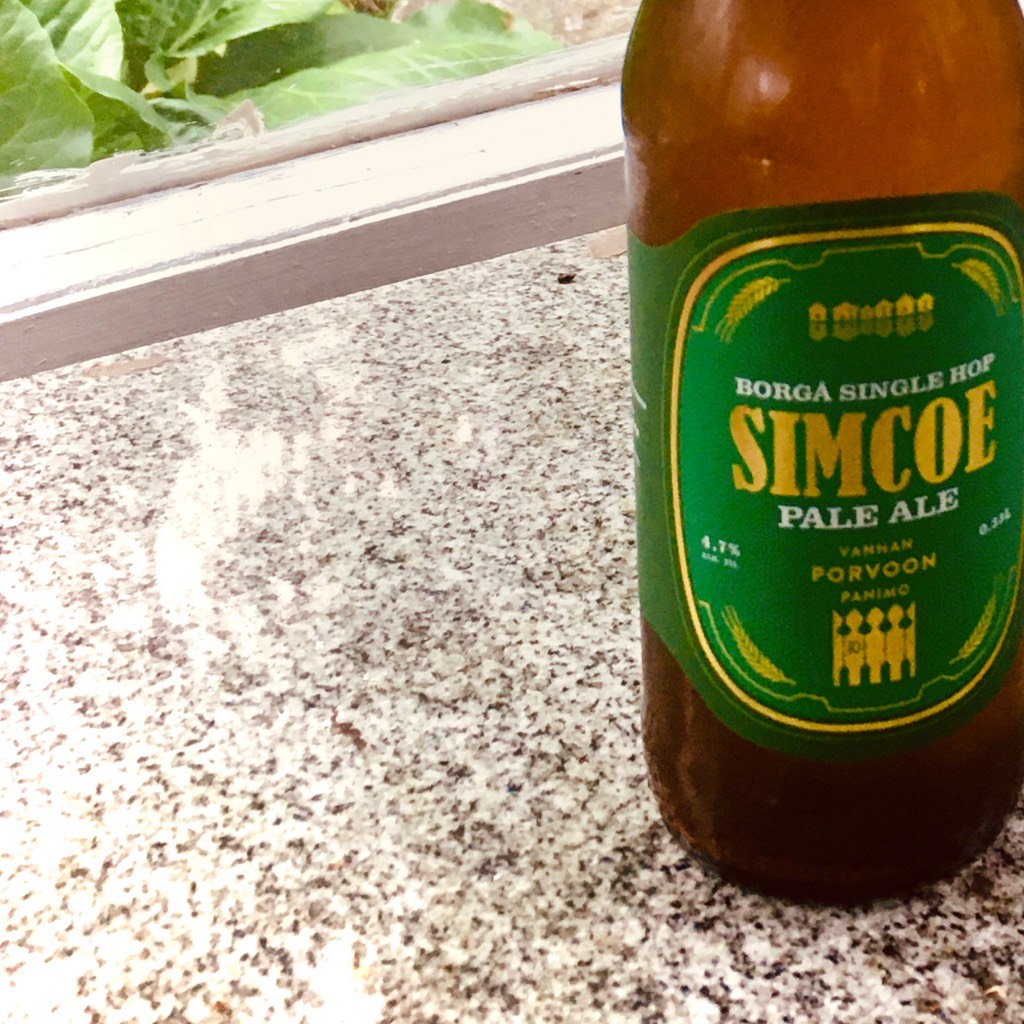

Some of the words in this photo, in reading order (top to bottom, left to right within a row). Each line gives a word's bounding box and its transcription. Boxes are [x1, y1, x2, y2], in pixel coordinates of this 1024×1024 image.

[839, 371, 943, 402] SINGLE
[950, 352, 996, 385] HOP
[729, 379, 997, 498] SIMCOE
[778, 504, 879, 529] PALE
[888, 487, 960, 525] ALE
[811, 552, 937, 584] PORVOON
[840, 583, 910, 604] PANIMO
